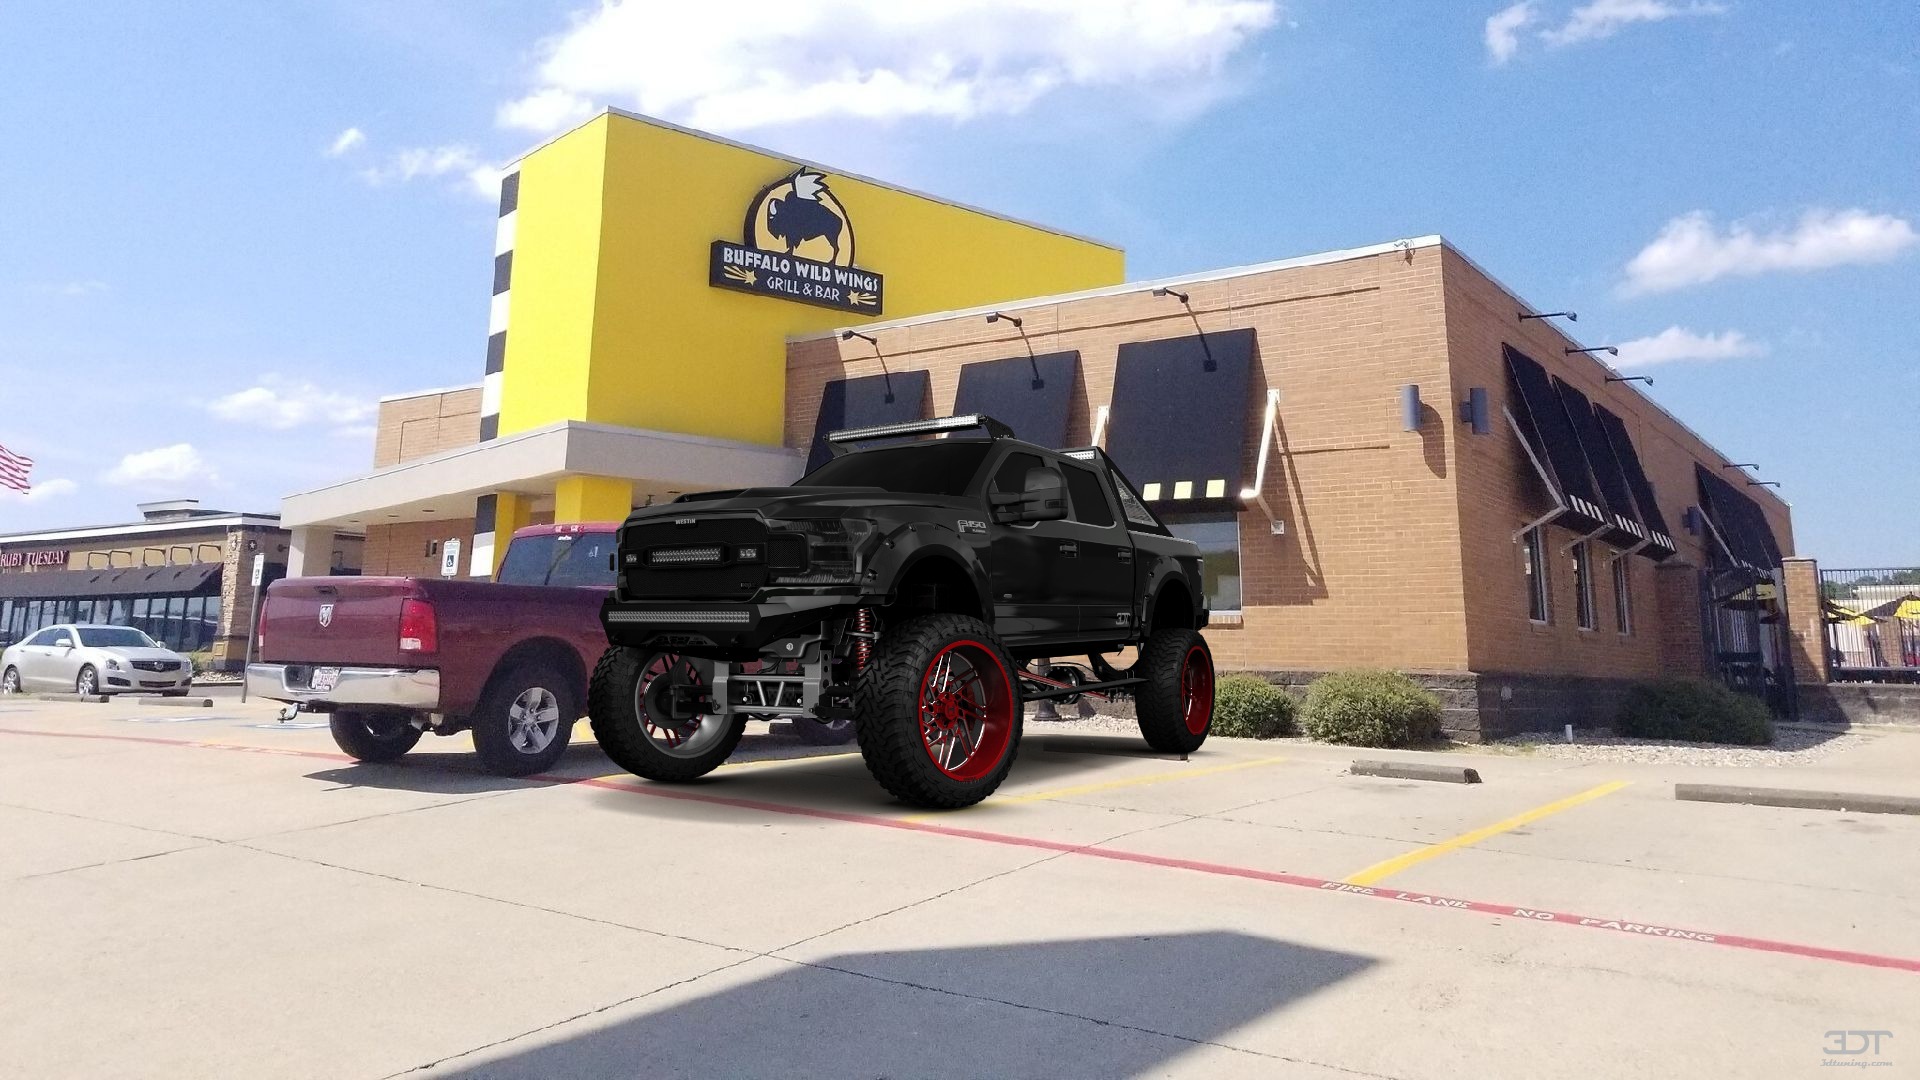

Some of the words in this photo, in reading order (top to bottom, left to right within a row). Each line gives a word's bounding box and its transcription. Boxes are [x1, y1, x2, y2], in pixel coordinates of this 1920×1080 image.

[723, 247, 790, 274] BUFFALO
[795, 261, 831, 282] WILD
[835, 269, 878, 292] WINGS
[767, 276, 800, 295] GRILL
[803, 283, 813, 297] &
[816, 285, 840, 302] BAR
[0, 553, 23, 567] RUBY
[27, 550, 65, 565] TUESDAY
[1320, 881, 1376, 896] FIRE
[1396, 892, 1472, 909] LANE
[1513, 908, 1555, 921] NO
[1579, 917, 1716, 943] PARKING
